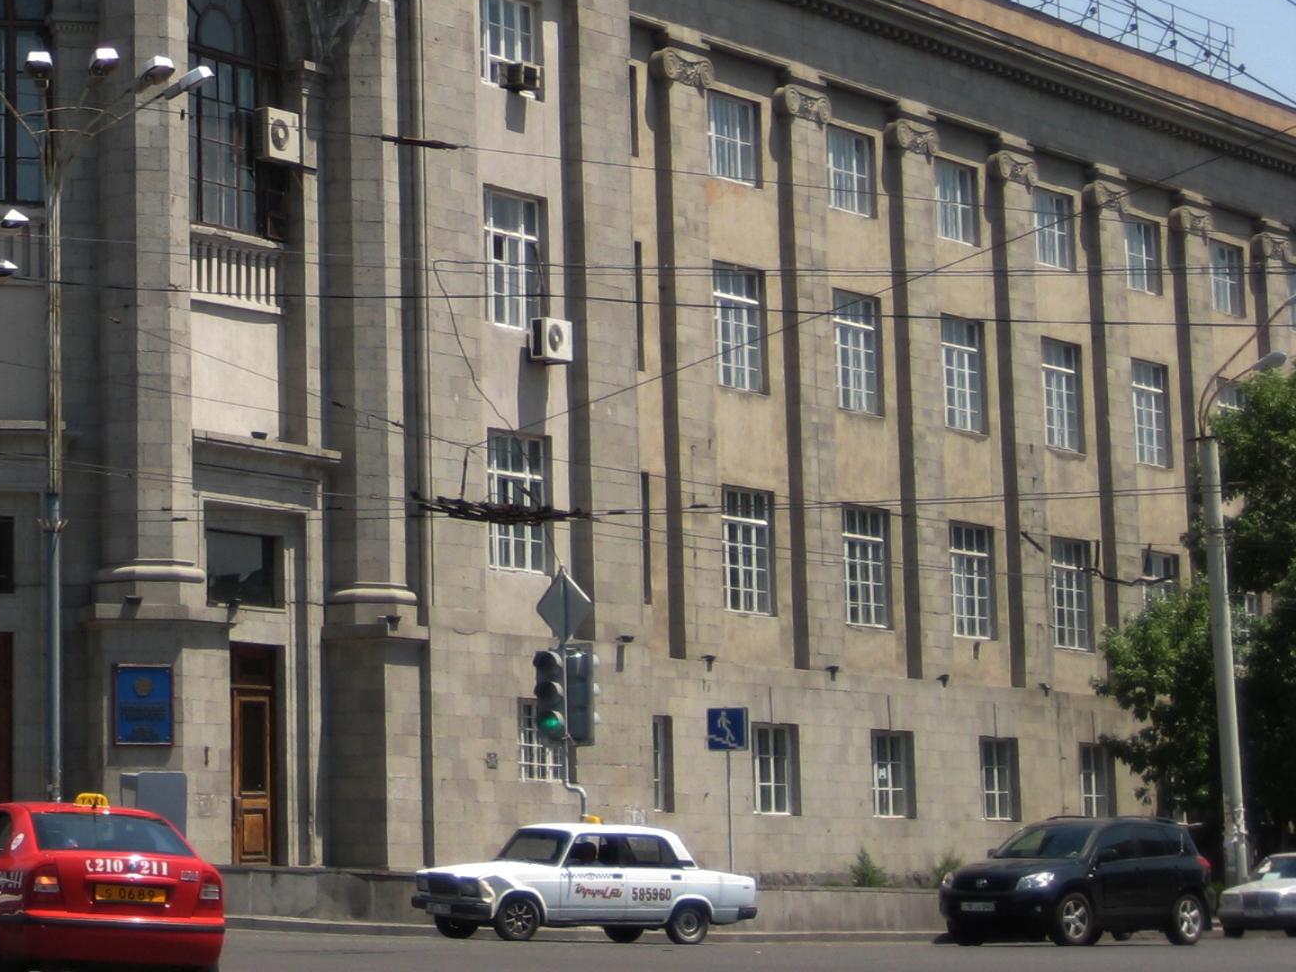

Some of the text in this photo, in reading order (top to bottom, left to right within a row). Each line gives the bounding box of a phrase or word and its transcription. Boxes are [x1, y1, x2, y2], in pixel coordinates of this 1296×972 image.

[80, 797, 105, 806] TAXI
[95, 859, 168, 875] 210 211
